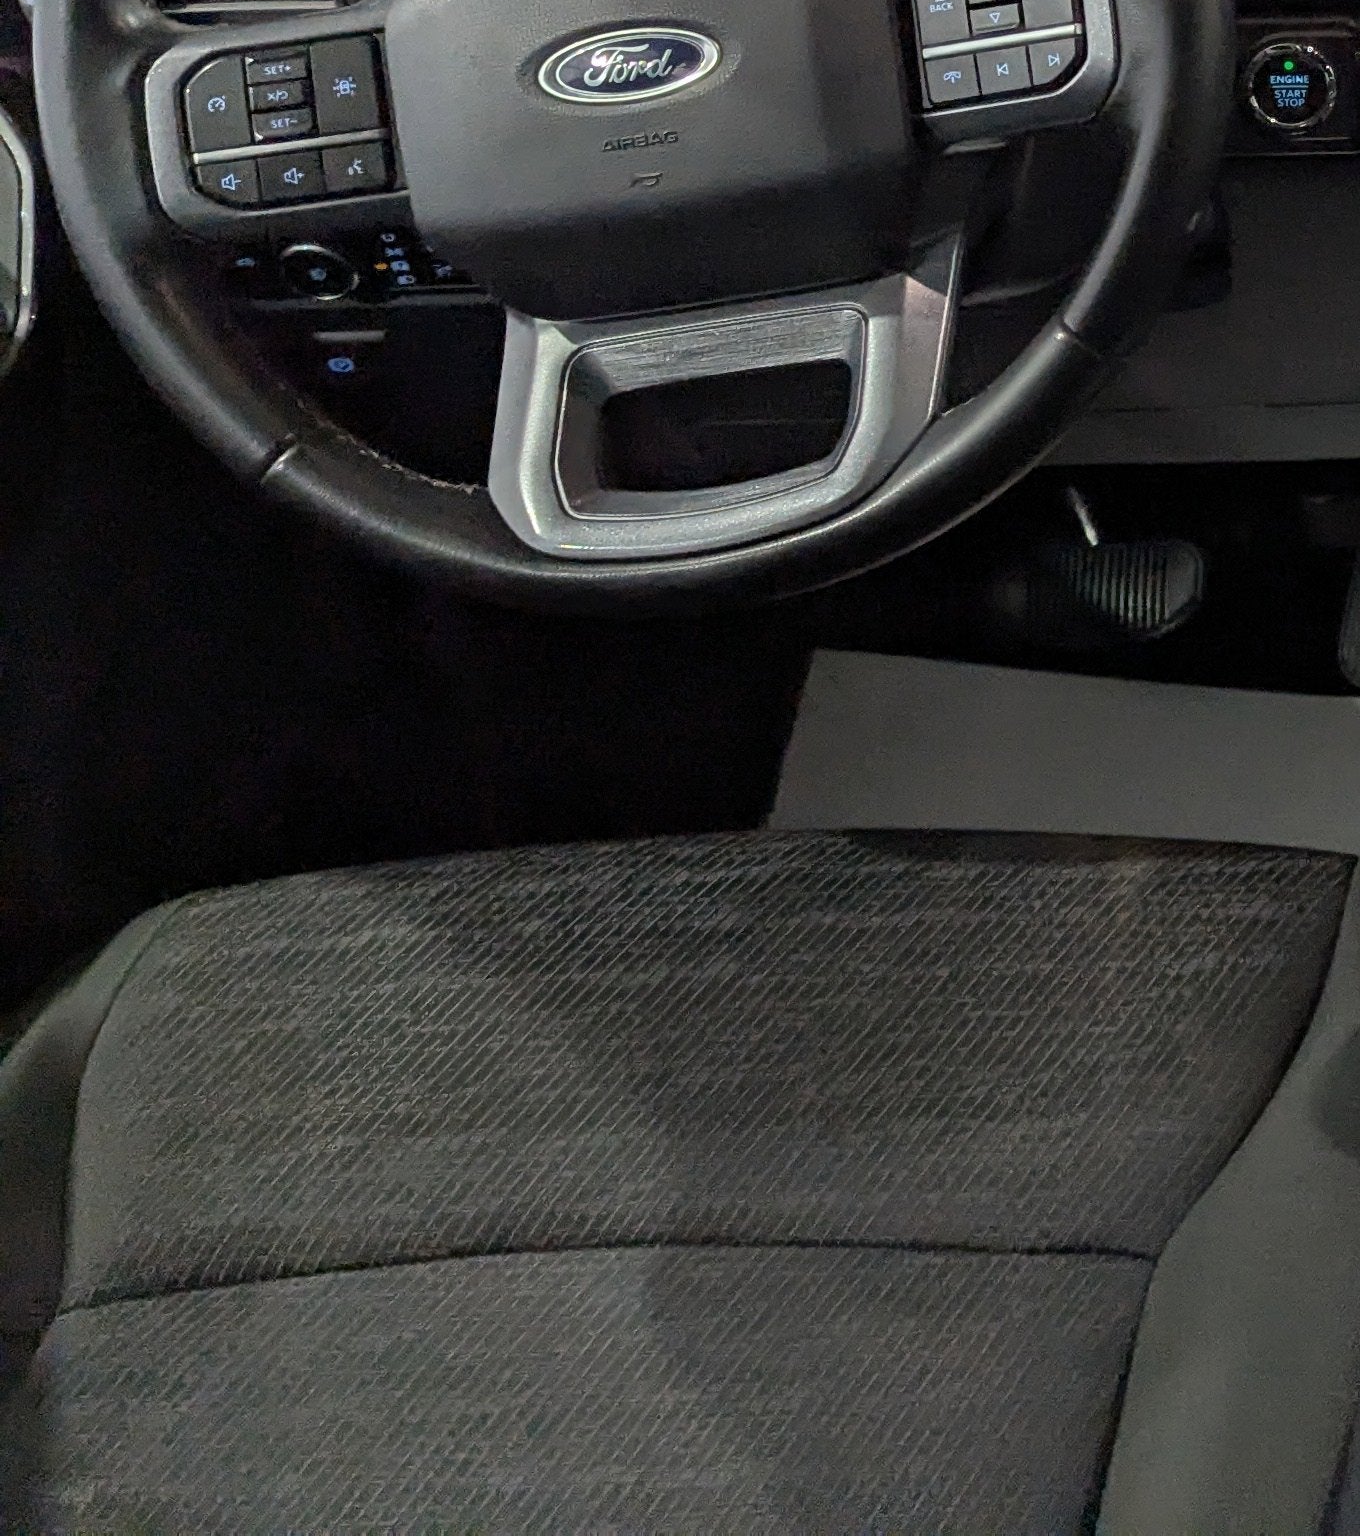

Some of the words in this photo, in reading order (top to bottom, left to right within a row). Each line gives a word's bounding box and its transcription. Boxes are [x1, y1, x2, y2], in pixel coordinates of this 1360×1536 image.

[929, 2, 954, 13] BACK
[583, 43, 687, 87] Ford
[1269, 74, 1310, 84] ENGINE
[1274, 89, 1308, 98] START
[1277, 98, 1305, 107] STOP
[602, 130, 680, 153] AIRBAG
